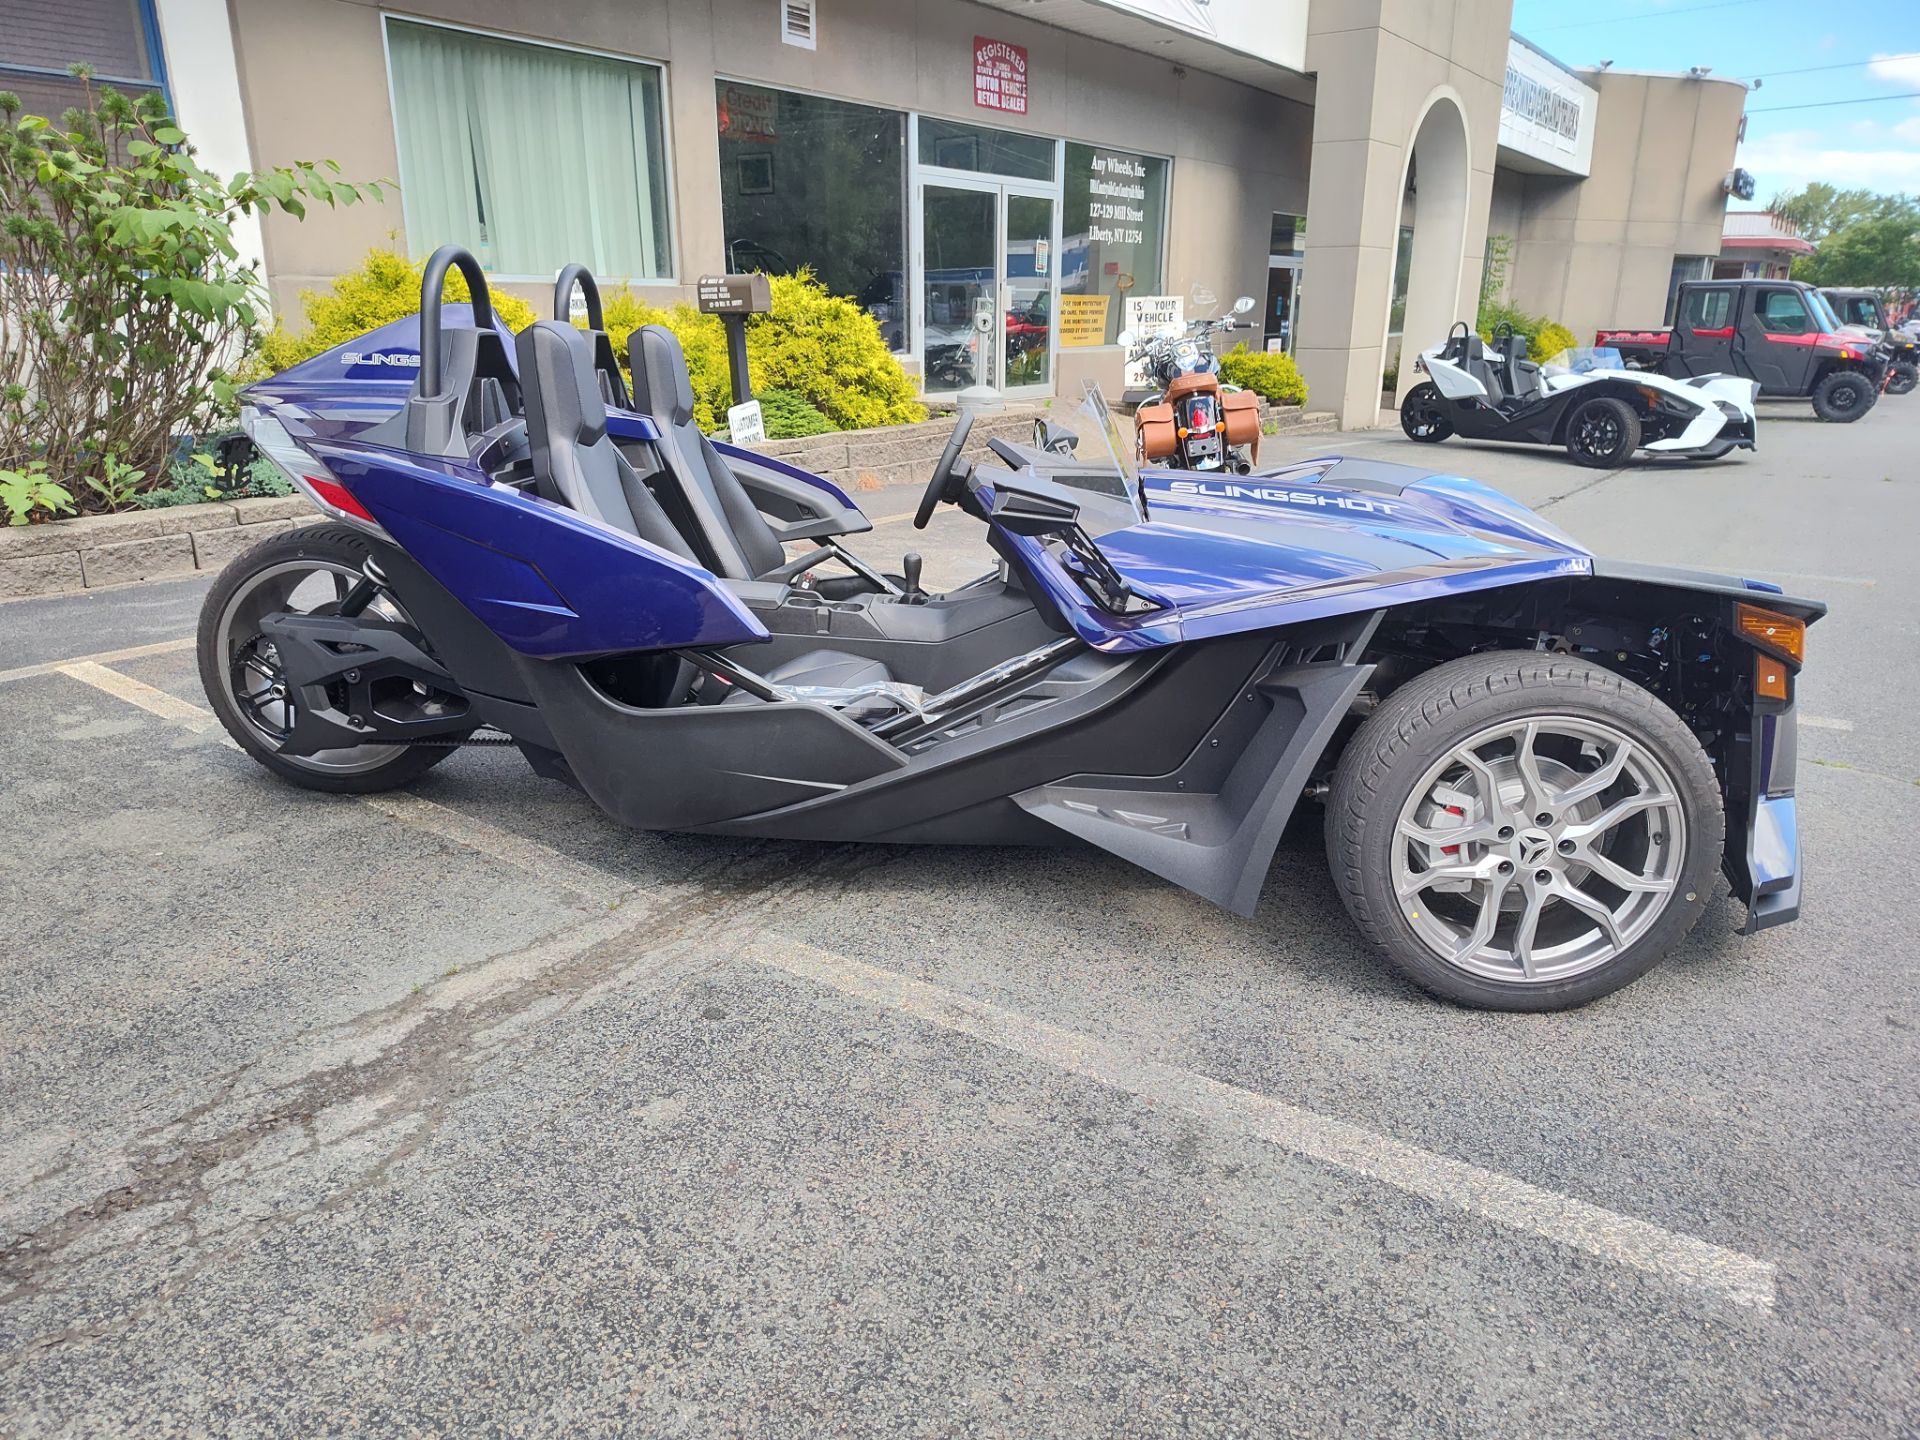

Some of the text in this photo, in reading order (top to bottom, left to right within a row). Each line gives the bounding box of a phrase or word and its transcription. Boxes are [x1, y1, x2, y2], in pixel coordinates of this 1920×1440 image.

[976, 43, 1025, 72] REGISTERED
[977, 65, 992, 75] STATE
[1001, 71, 1012, 79] NEW
[976, 74, 1026, 97] MOTOR VEHICLE
[977, 90, 1025, 112] RETAIL DEALER
[1091, 155, 1146, 177] Any Wheels, Inc
[1089, 202, 1144, 222] 127-129 Mill Street
[1089, 225, 1114, 246] Liberty,
[1113, 228, 1125, 242] NY
[1133, 300, 1177, 311] IS YOUR
[1136, 312, 1174, 323] VEHICLE
[340, 352, 420, 368] SLINGS
[1170, 481, 1401, 515] SLINGSHOT
